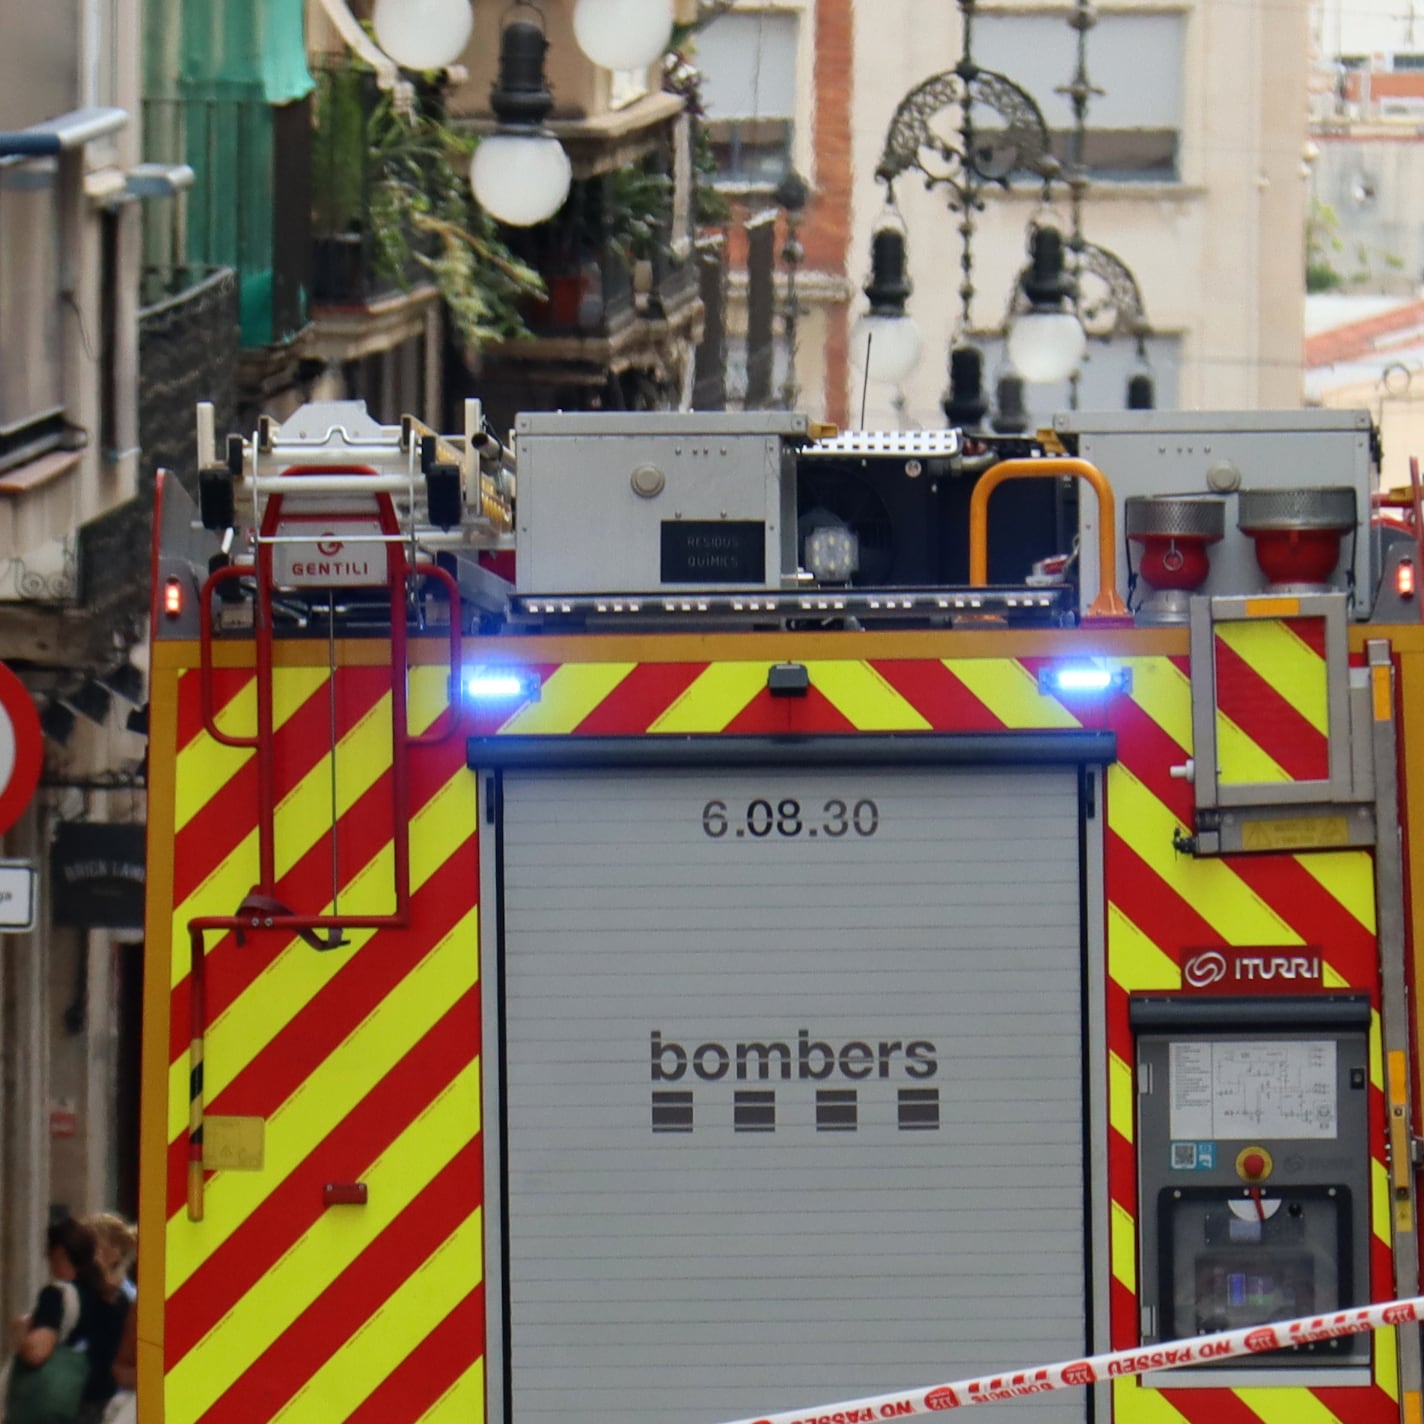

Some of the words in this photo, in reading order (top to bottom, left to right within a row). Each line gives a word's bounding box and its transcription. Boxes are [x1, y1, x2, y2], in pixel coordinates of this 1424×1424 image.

[686, 535, 740, 550] RESIDUS
[292, 562, 368, 576] GENTILI
[701, 798, 880, 840] 6.08.30
[1234, 956, 1320, 981] ITURRI
[650, 1028, 939, 1082] bombers
[1198, 1340, 1232, 1358] NO
[1107, 1346, 1194, 1377] PASSEU
[880, 1400, 913, 1418] NO
